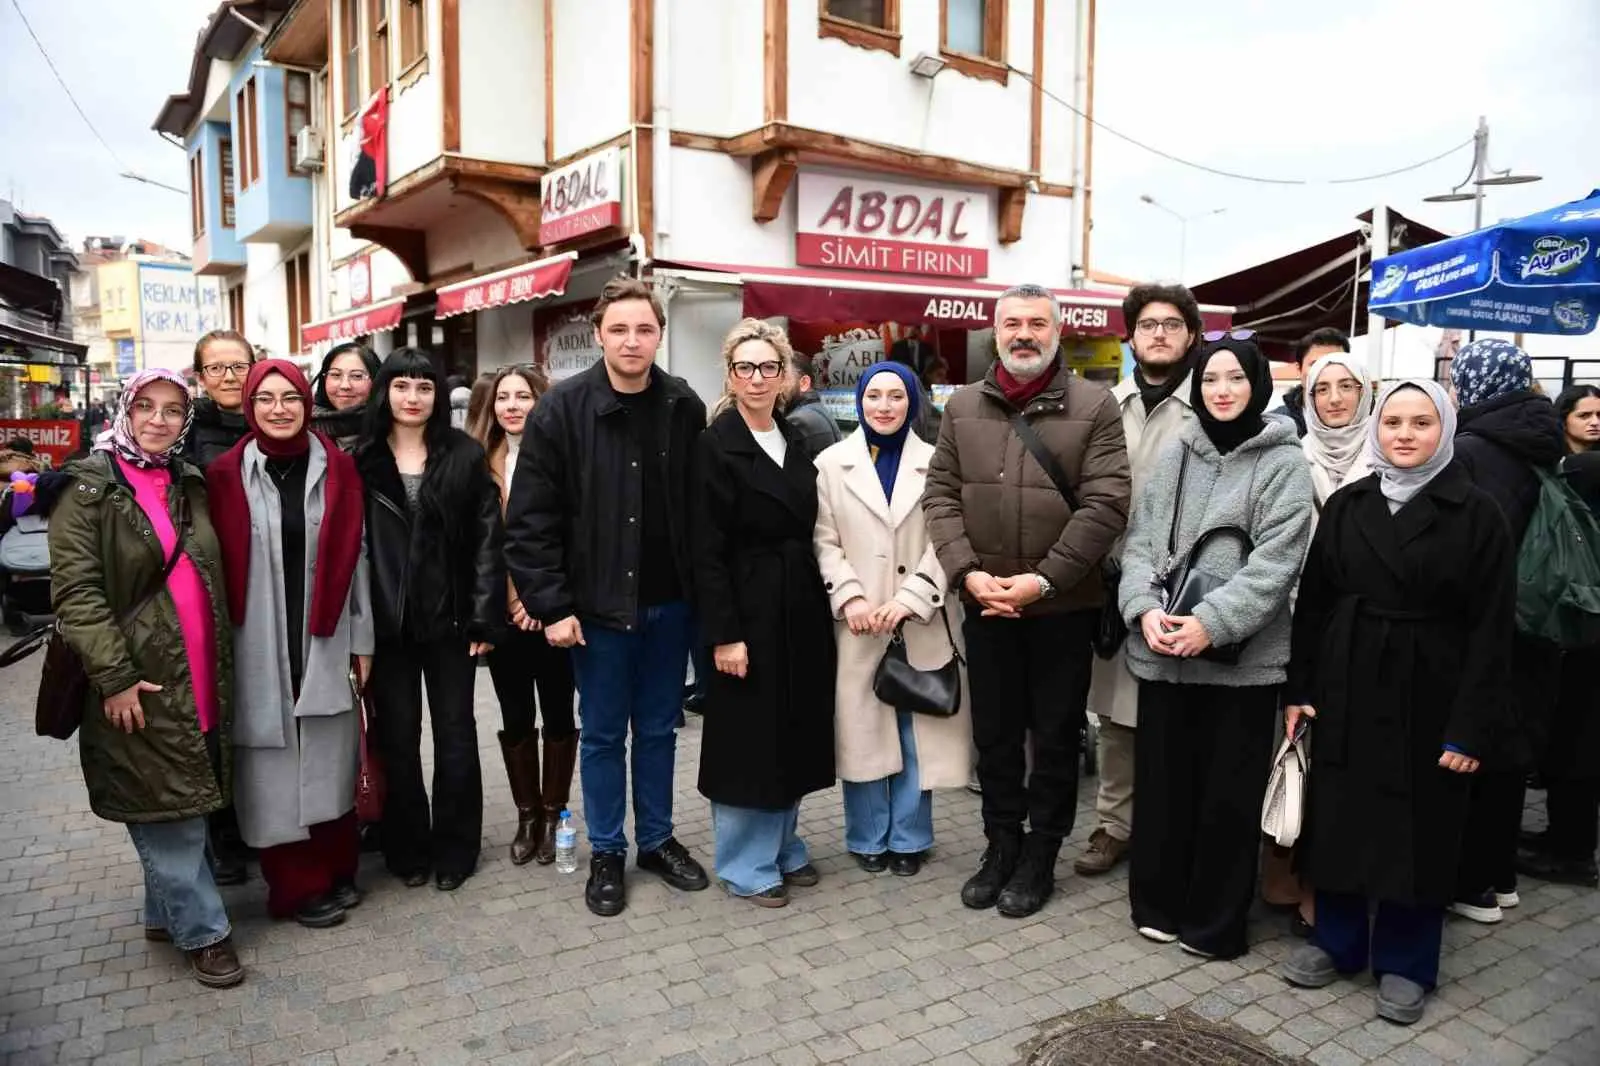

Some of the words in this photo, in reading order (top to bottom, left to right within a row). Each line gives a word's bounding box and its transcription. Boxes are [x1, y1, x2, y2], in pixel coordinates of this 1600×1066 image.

[541, 160, 608, 215] ABDAL
[818, 186, 968, 241] ABDAL
[820, 238, 893, 268] SİMİT
[902, 248, 972, 274] FIRINI
[1528, 246, 1580, 272] Ayran
[924, 299, 988, 321] ABDAL
[1059, 307, 1108, 329] HÇESI
